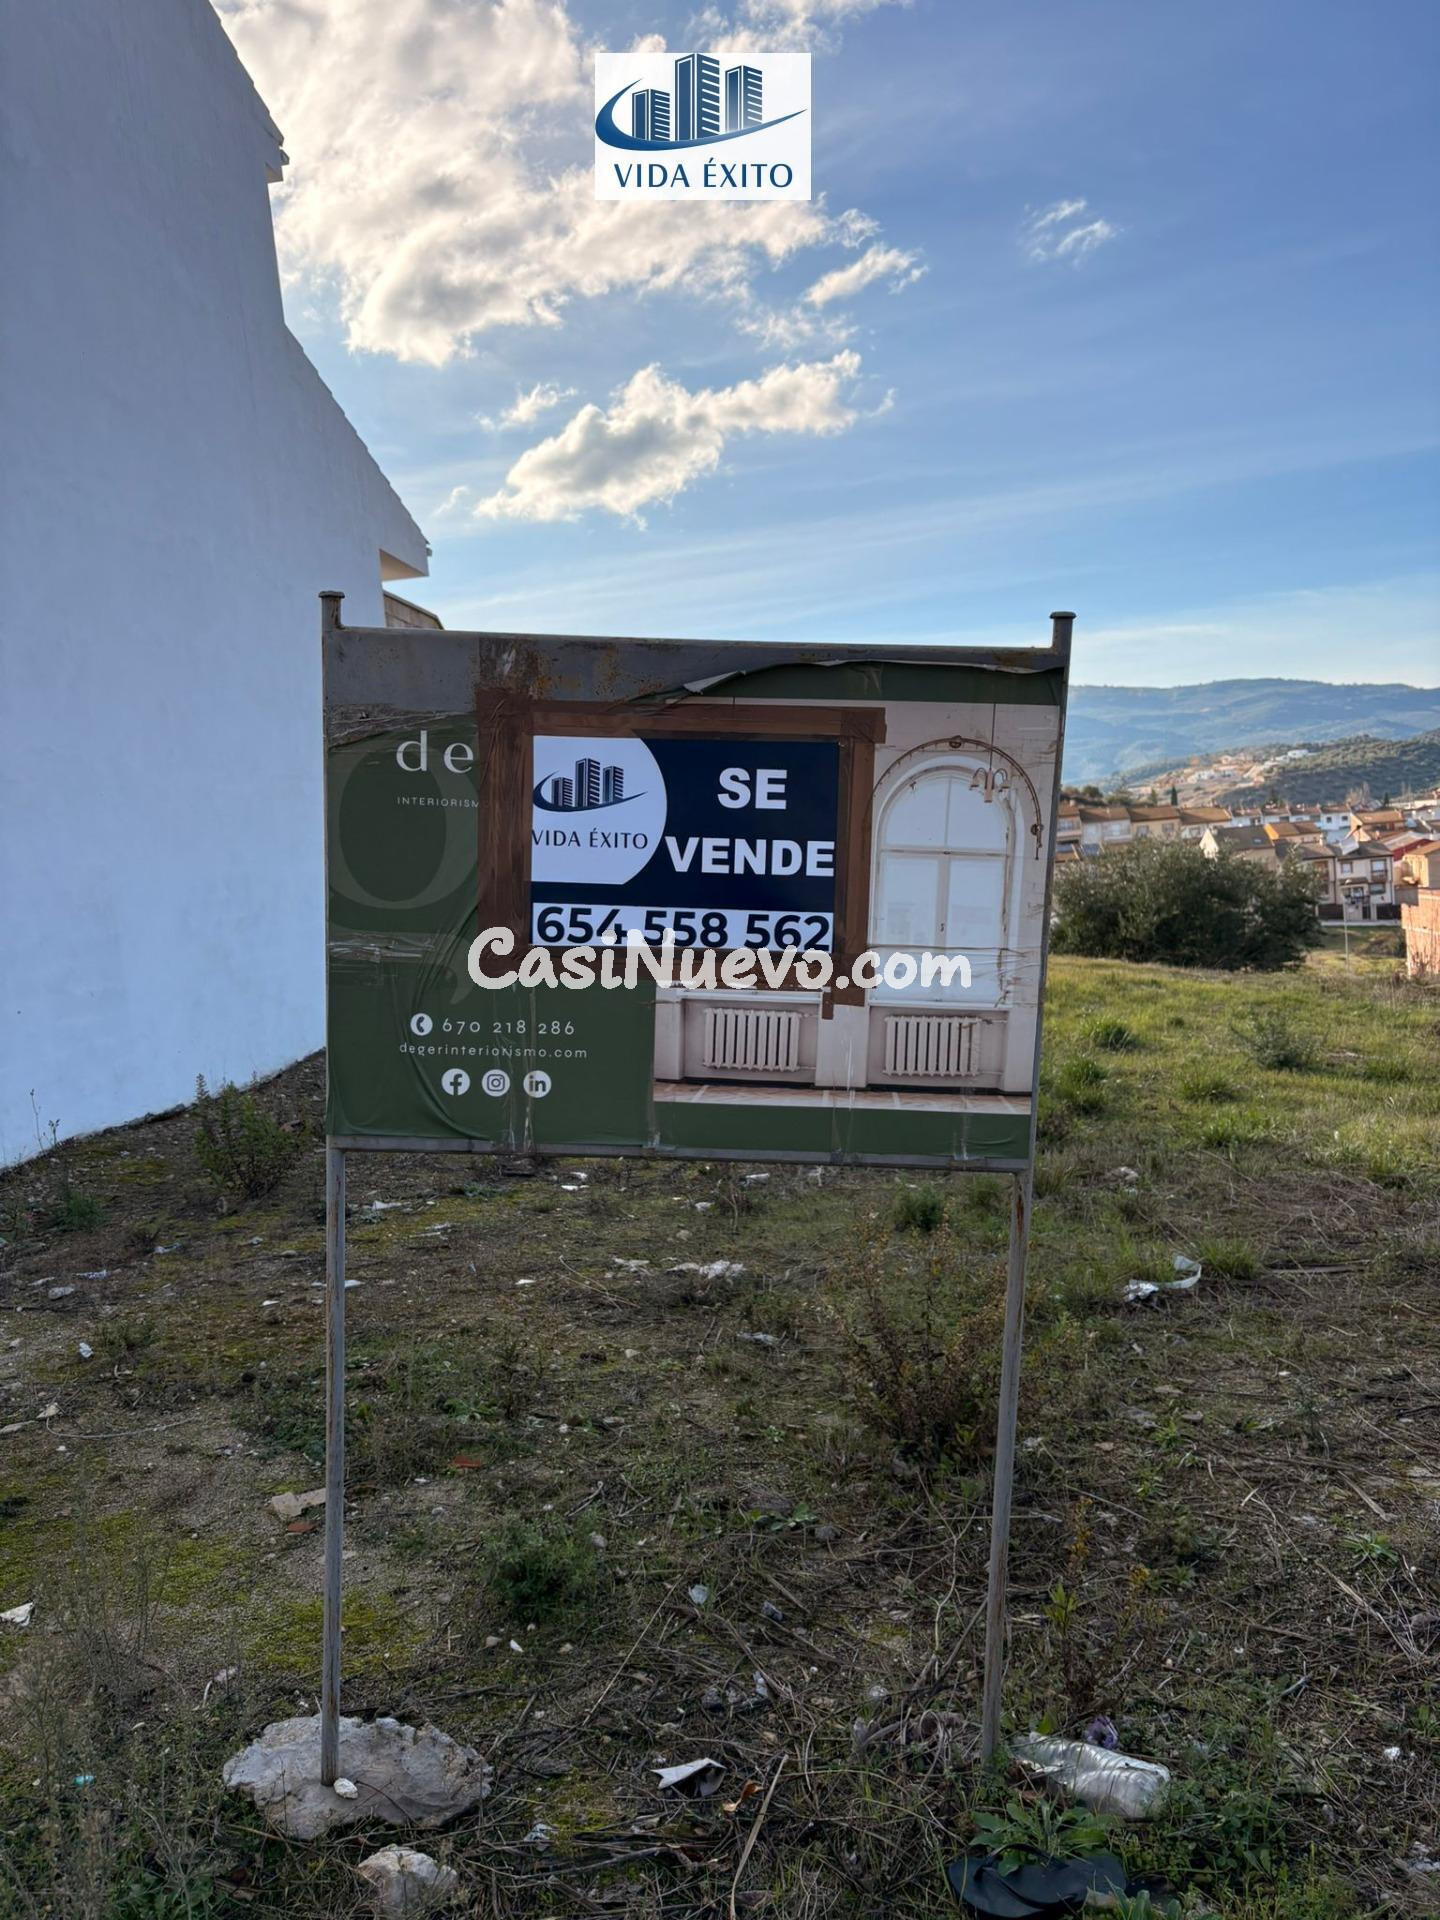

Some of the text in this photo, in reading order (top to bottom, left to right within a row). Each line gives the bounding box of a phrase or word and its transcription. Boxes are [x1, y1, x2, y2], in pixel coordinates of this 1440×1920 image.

[717, 767, 788, 810] SE
[532, 827, 649, 850] VIDA ÉXITO
[665, 836, 835, 877] VENDE
[537, 906, 830, 950] 654 558 562
[442, 1018, 575, 1036] 670 218 286
[399, 1041, 588, 1059] degerinteriorismo.com
